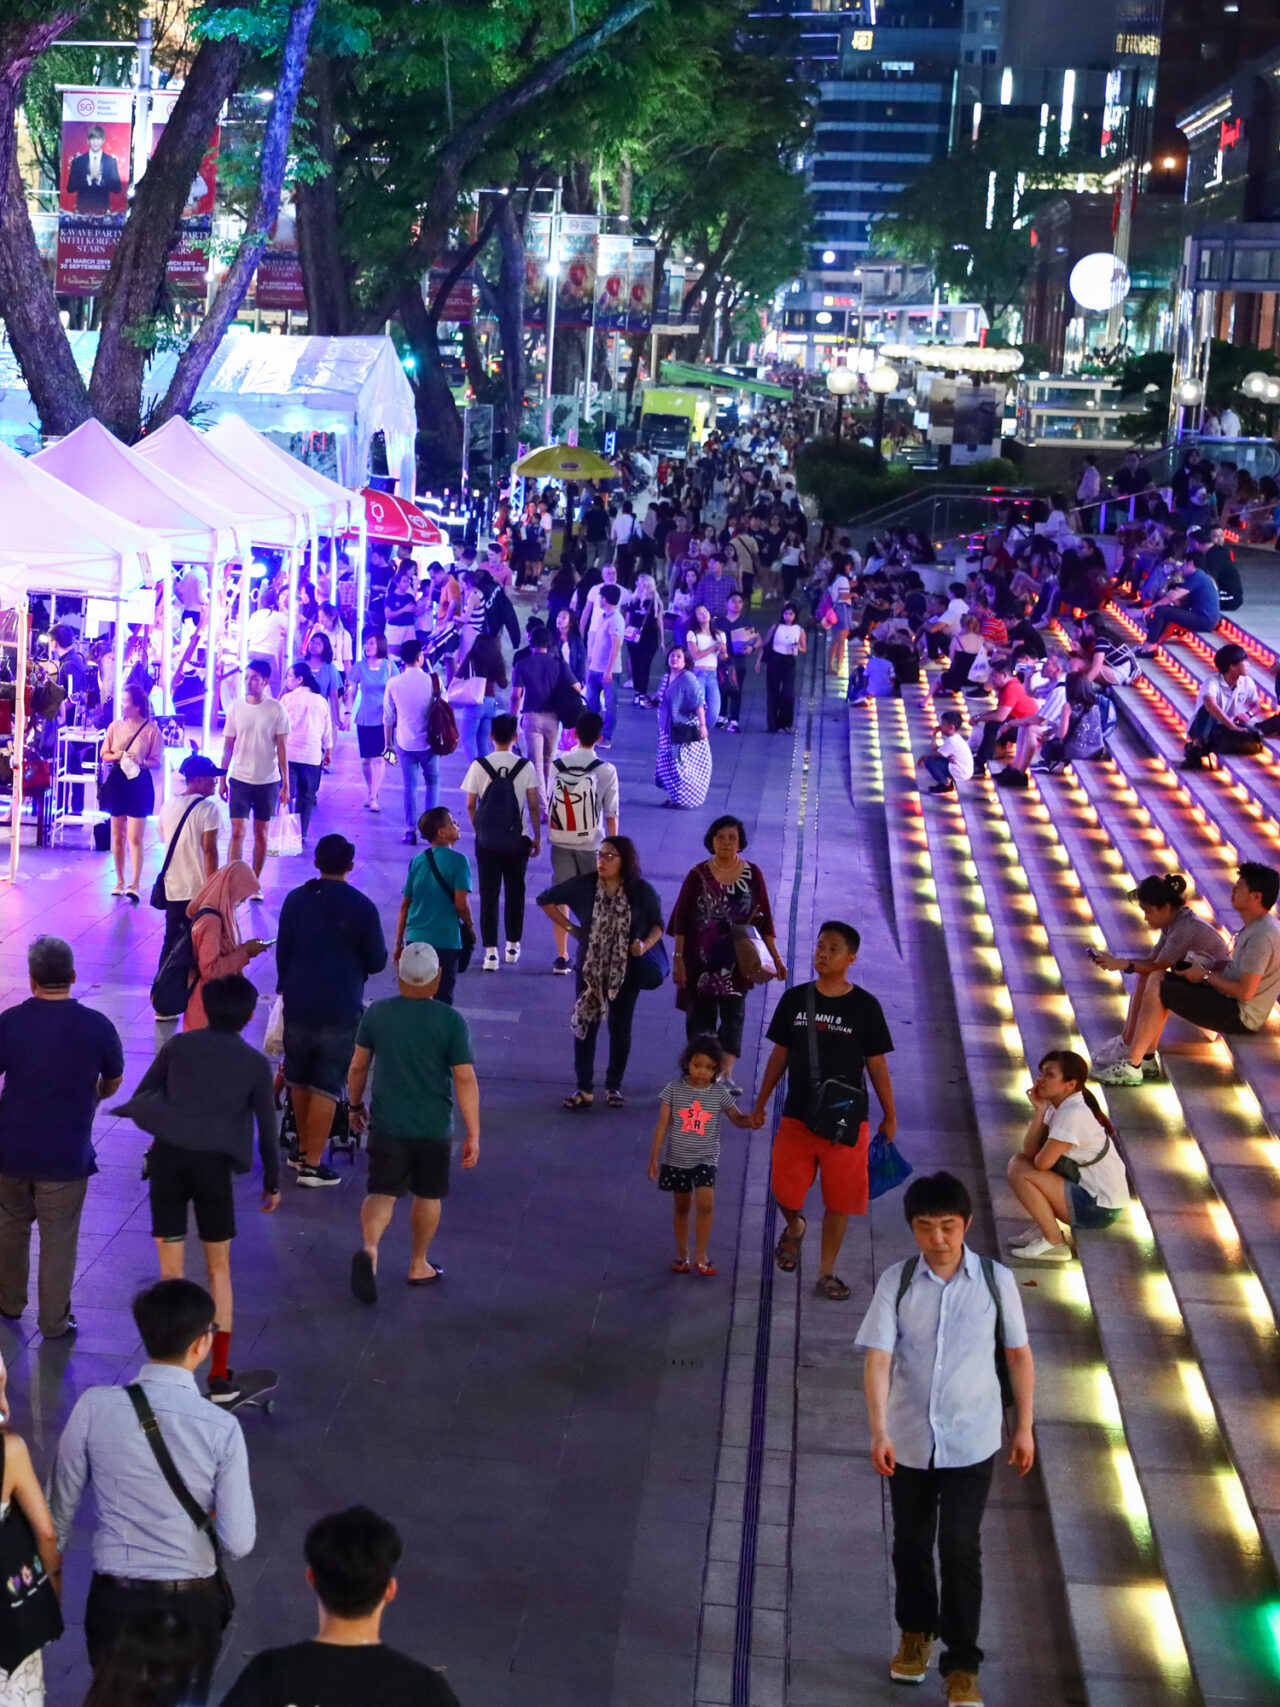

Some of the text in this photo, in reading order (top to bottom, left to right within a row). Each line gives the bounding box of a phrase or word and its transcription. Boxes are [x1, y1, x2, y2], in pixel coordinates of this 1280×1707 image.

[79, 103, 93, 112] SG
[95, 229, 123, 239] PARTY
[59, 236, 84, 245] WITH
[77, 245, 106, 253] STARS
[795, 1012, 834, 1024] ALMNI
[827, 1023, 853, 1034] TUJUAN
